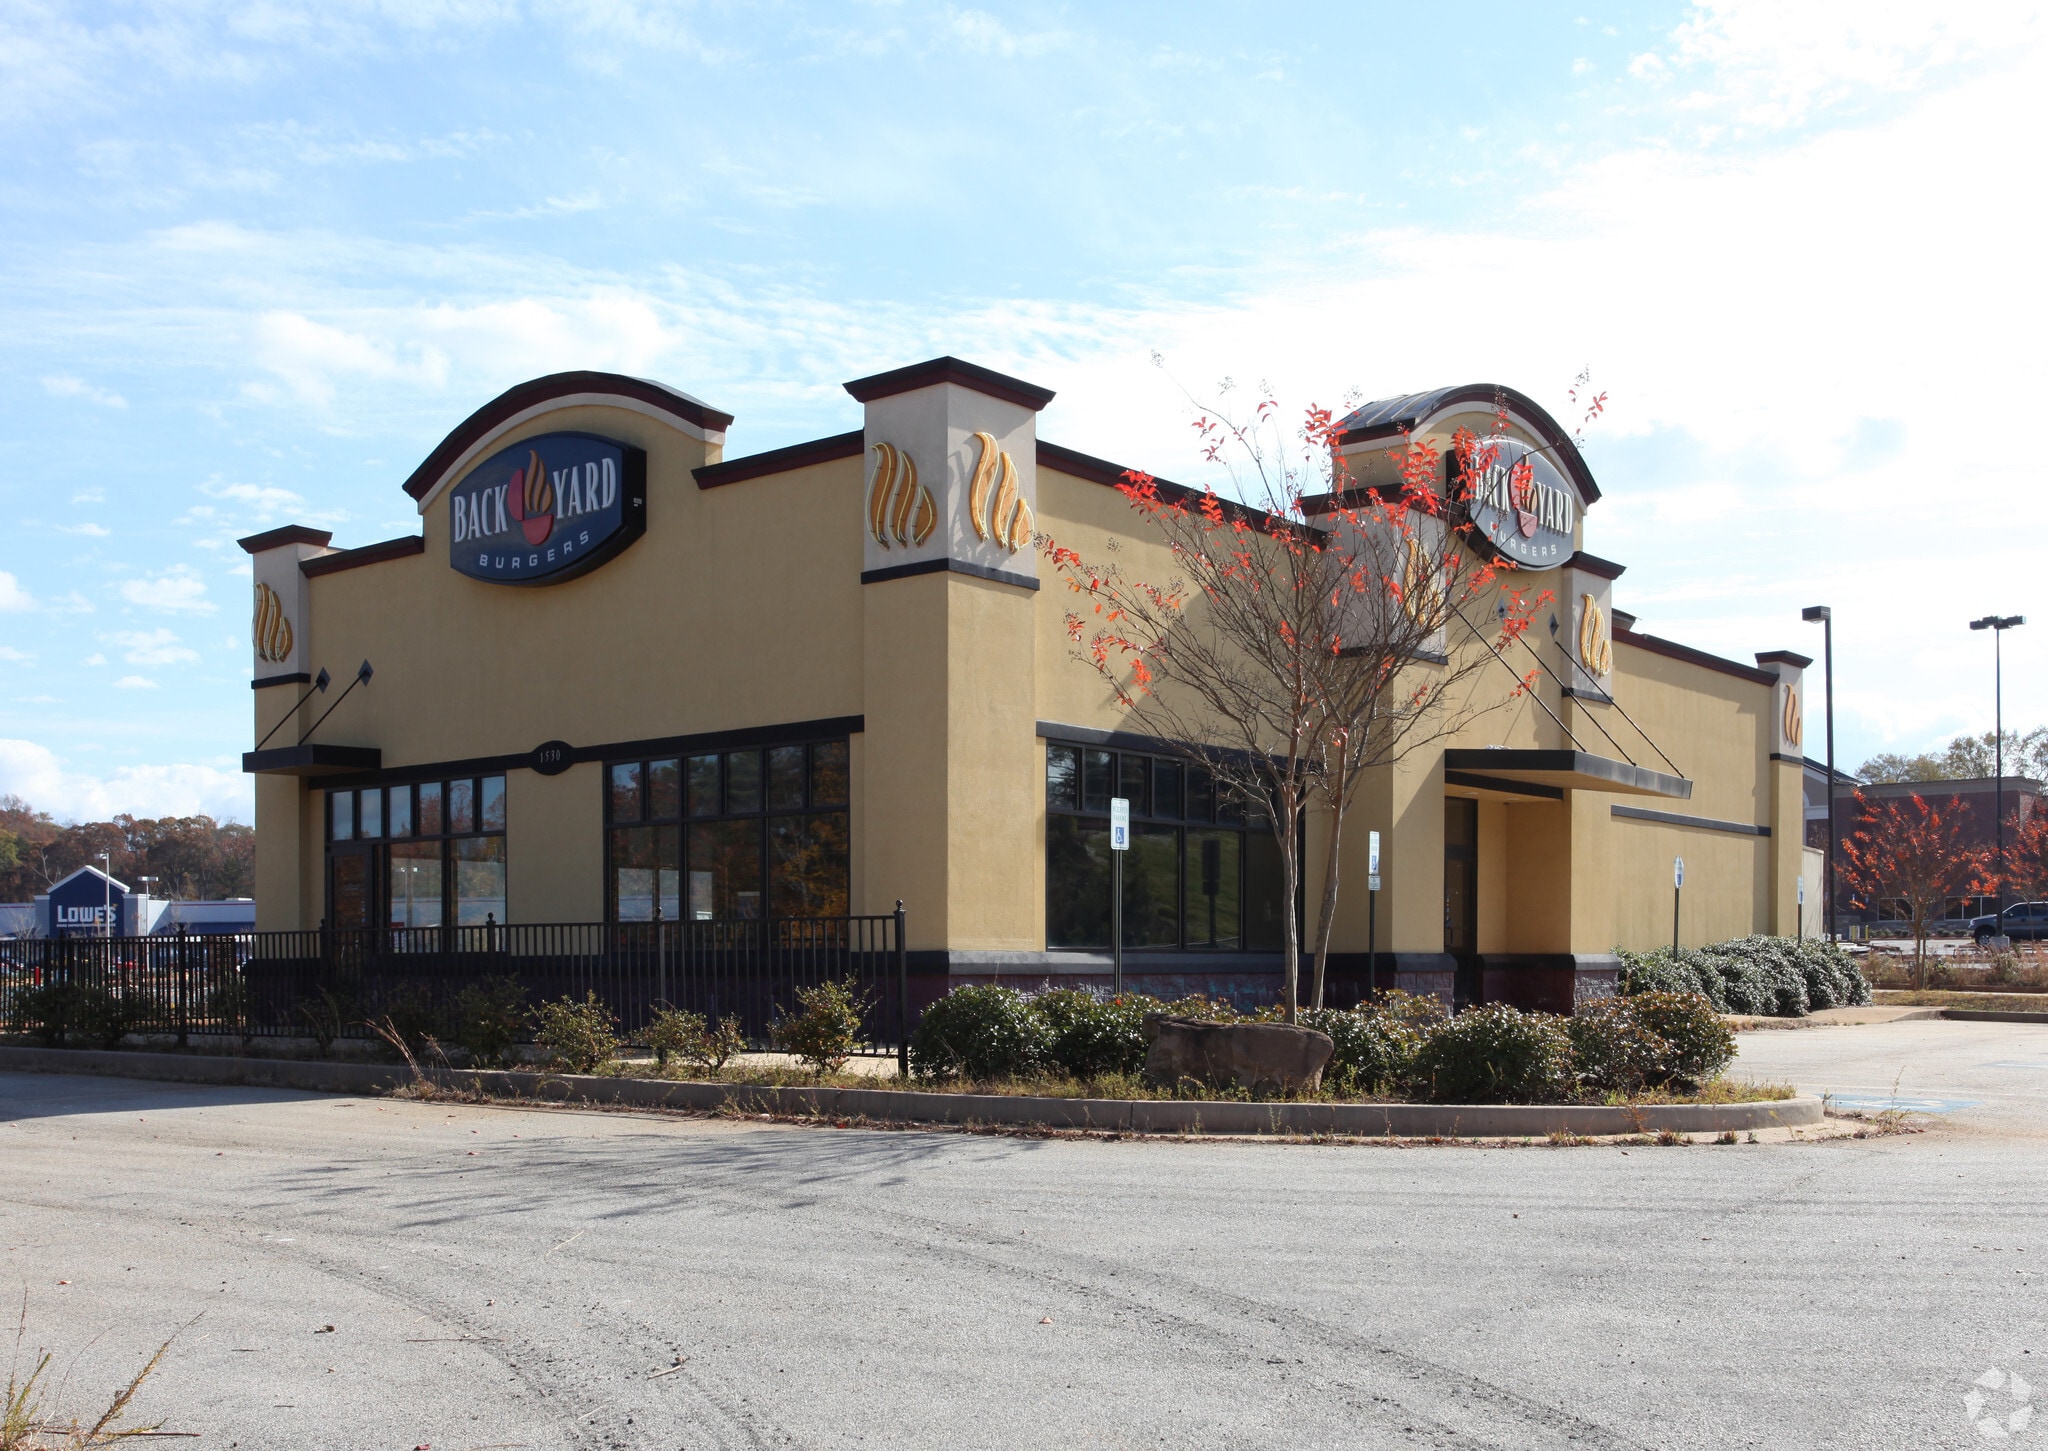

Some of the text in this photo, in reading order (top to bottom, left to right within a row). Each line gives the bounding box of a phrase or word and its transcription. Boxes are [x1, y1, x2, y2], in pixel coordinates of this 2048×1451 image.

[454, 457, 617, 543] BACK YARD
[1536, 481, 1573, 534] YARD
[479, 530, 589, 569] BURGERS
[540, 749, 561, 764] 1530
[57, 905, 117, 923] LOWE'S
